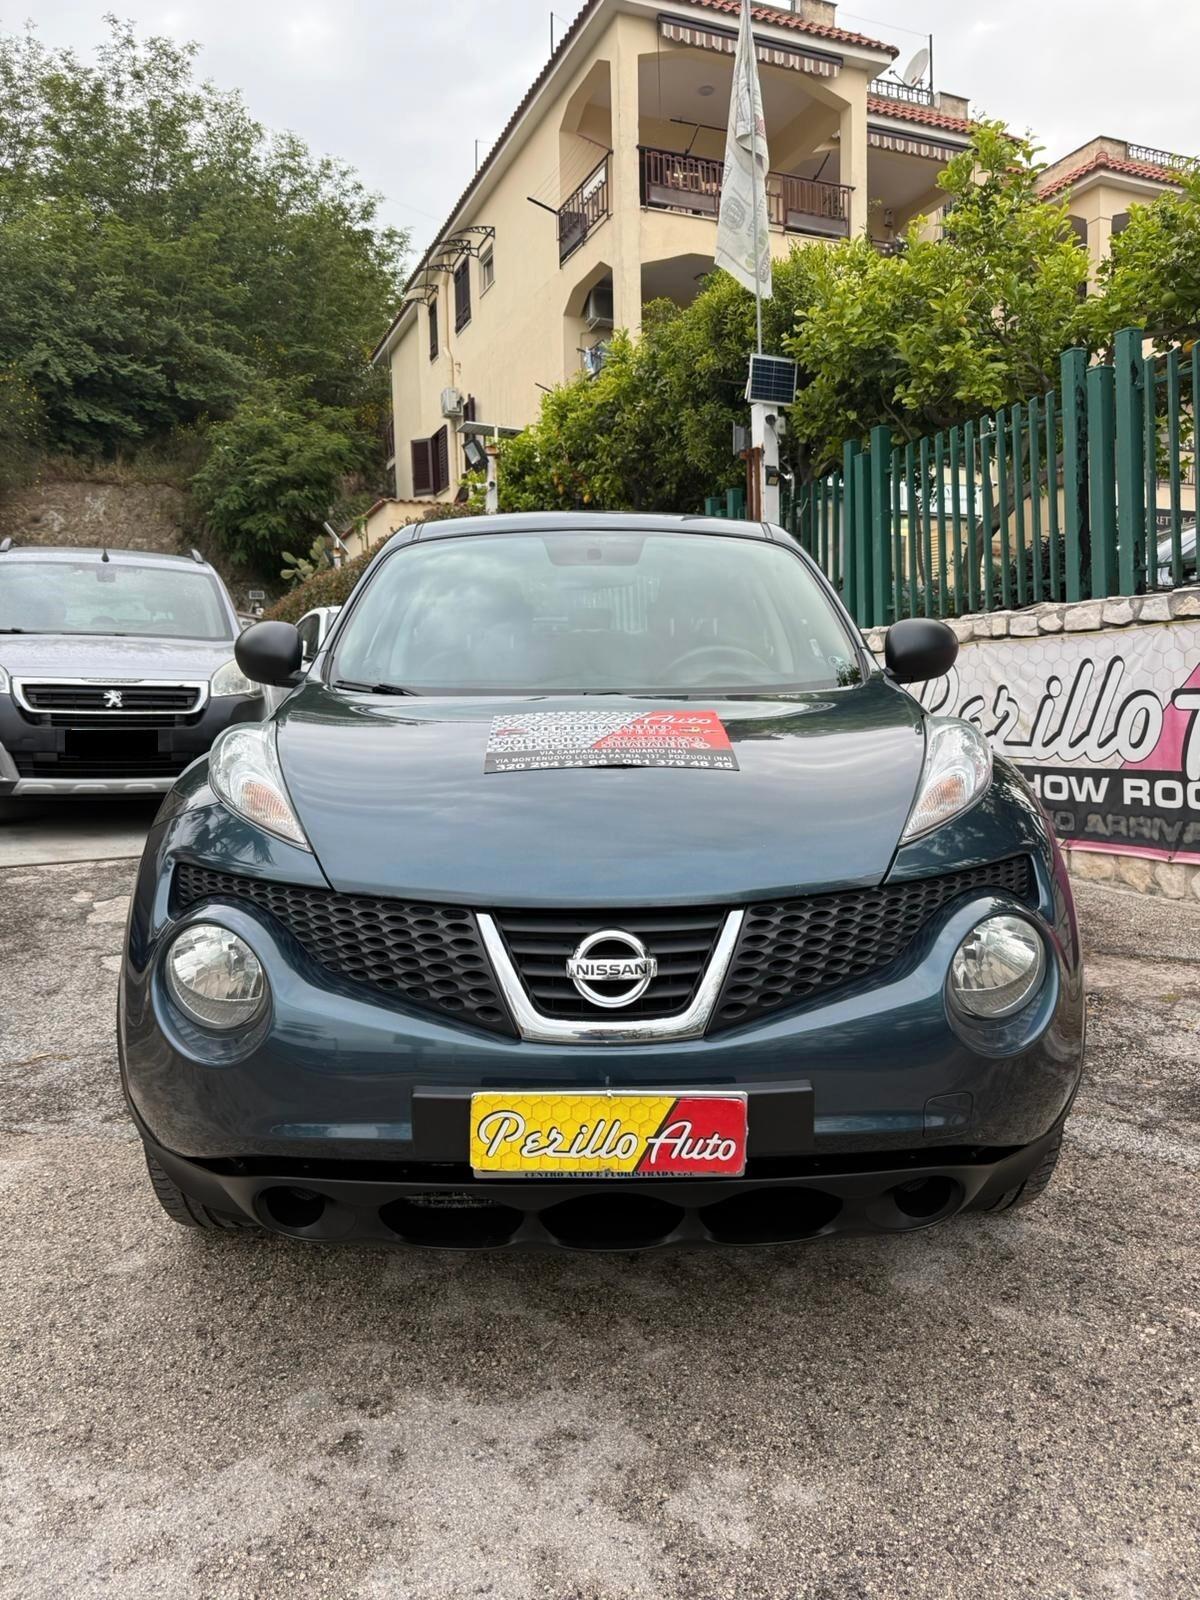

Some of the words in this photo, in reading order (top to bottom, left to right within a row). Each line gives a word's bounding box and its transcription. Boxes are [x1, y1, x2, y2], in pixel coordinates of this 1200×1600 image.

[639, 714, 712, 725] Auto
[496, 763, 526, 771] 320
[1030, 774, 1110, 803] HOW
[576, 963, 648, 976] NISSAN
[477, 1110, 639, 1160] Perillo
[646, 1120, 737, 1164] Auto
